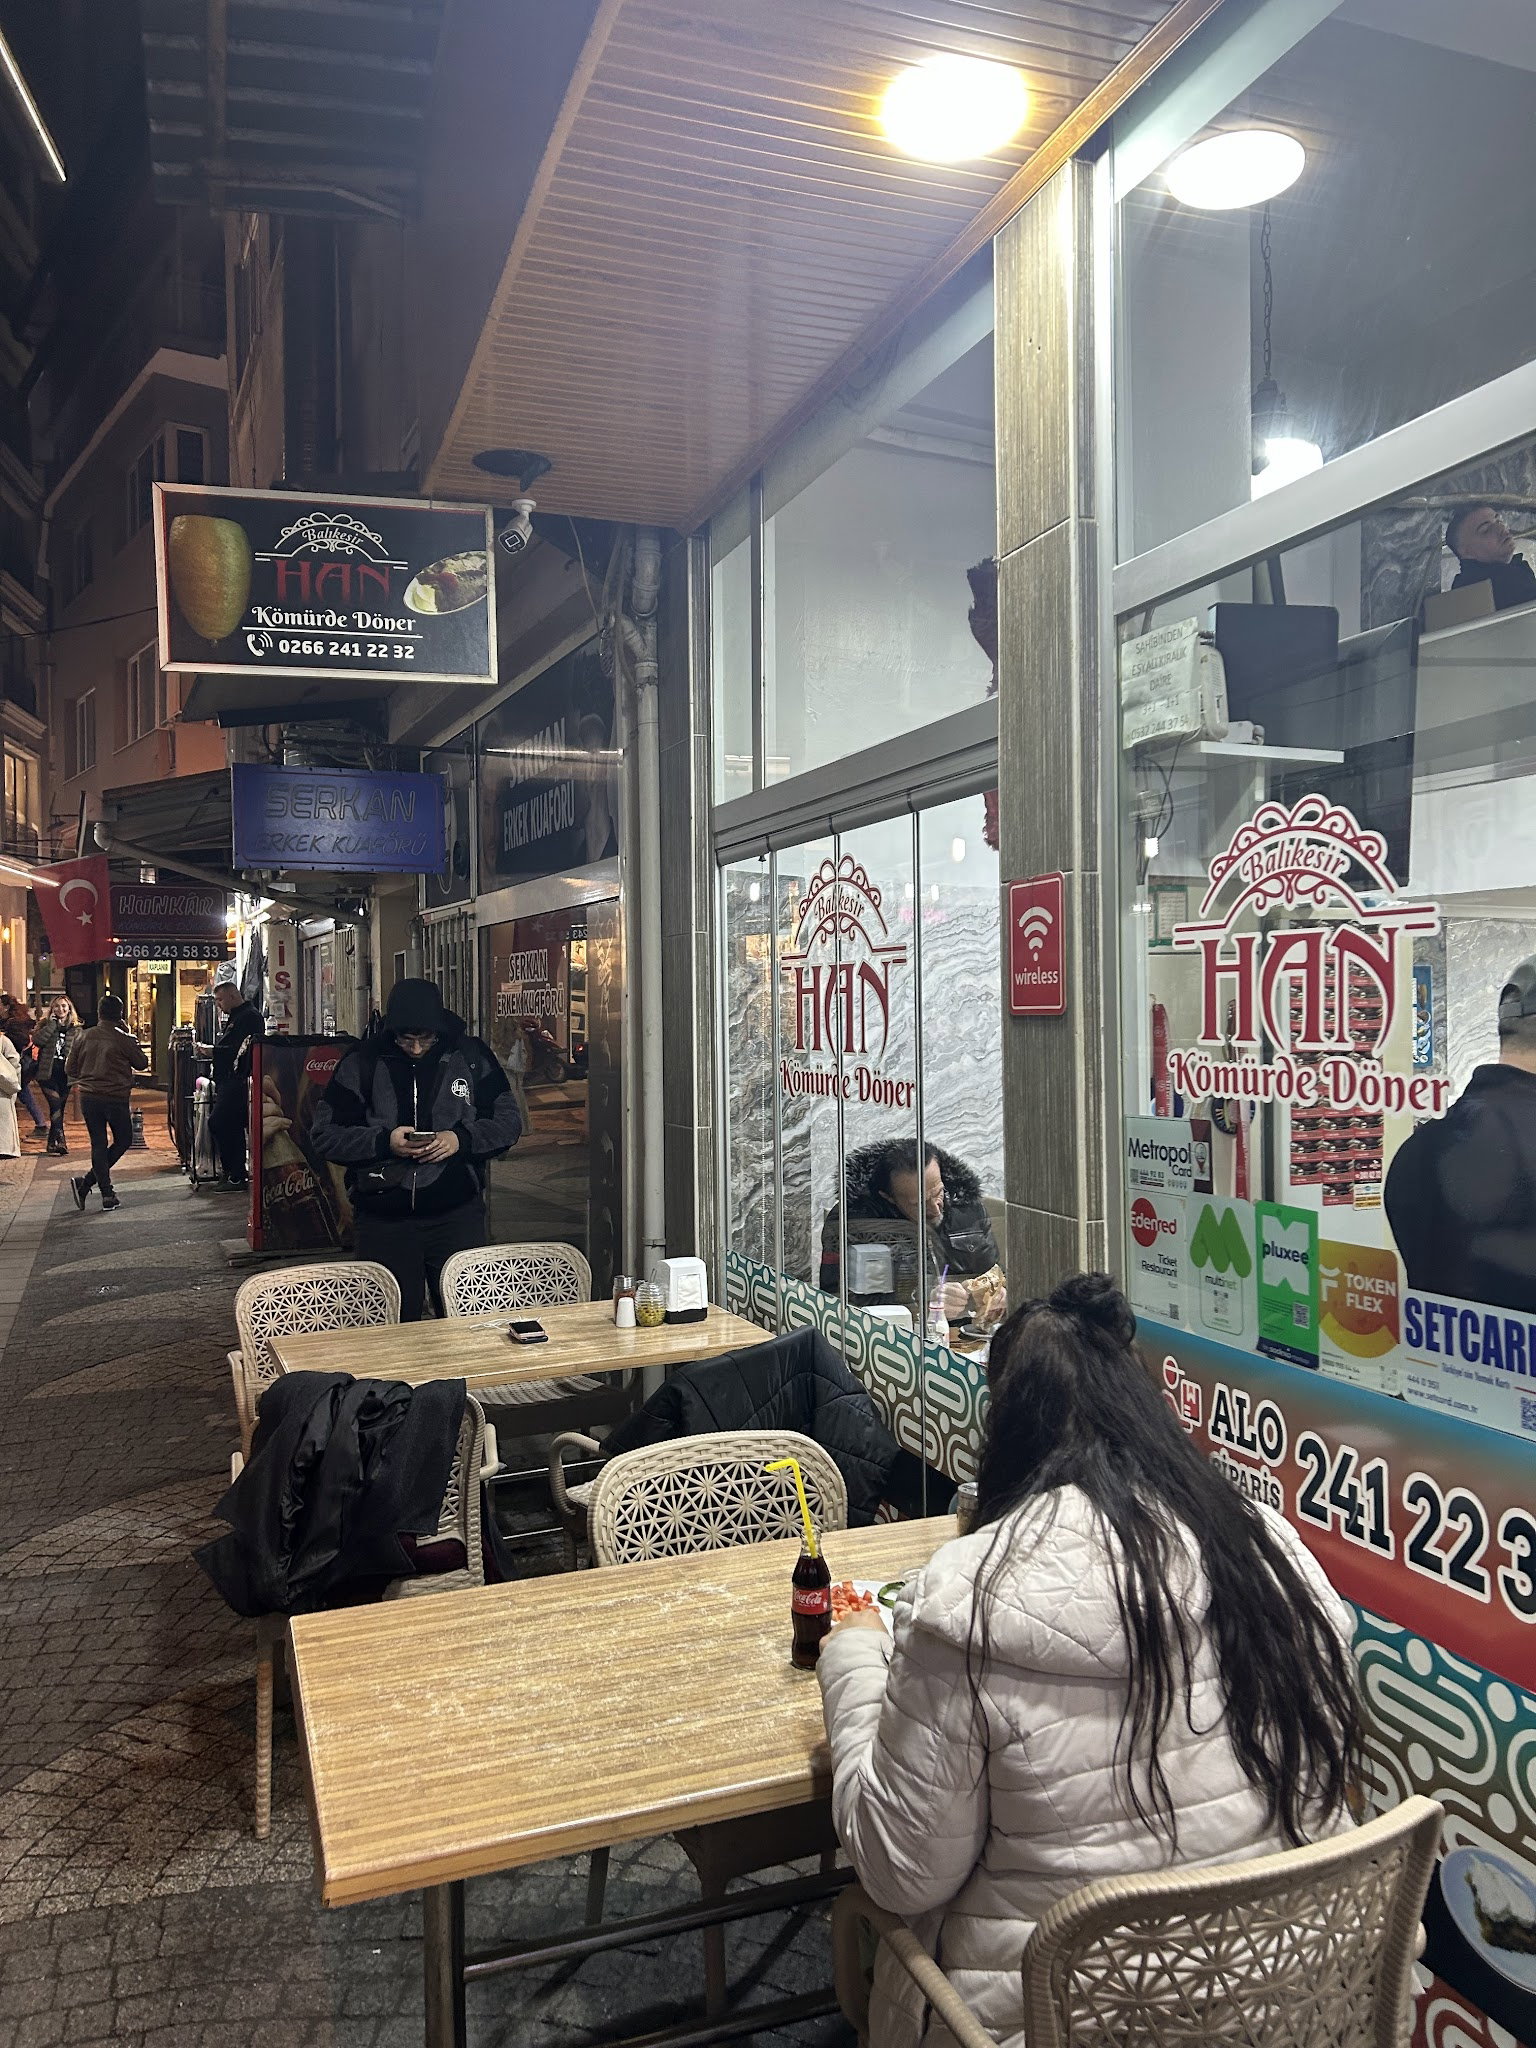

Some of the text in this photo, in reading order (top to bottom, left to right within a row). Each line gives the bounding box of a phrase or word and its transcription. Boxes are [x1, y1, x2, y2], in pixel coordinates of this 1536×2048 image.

[301, 526, 364, 546] Balıkesir
[275, 559, 391, 604] HAN
[251, 606, 417, 632] Kömürde Döner
[278, 639, 415, 660] 0266 241 22 32
[510, 717, 566, 789] SERKAN
[264, 782, 416, 823] SERKAN
[503, 801, 529, 852] ERKEK
[255, 832, 325, 854] ERKEK
[1241, 838, 1348, 886] Balıkesir
[116, 945, 219, 958] 0266 243 58 33
[509, 948, 548, 984] SERKAN
[1014, 966, 1059, 986] wireless
[496, 982, 565, 1018] ERKEK KUAFÖRÜ
[1199, 926, 1400, 1052] HAN
[794, 960, 889, 1060] HAN
[305, 1058, 341, 1072] Coca-Col
[779, 1059, 915, 1109] Kömürde Döner
[1170, 1052, 1315, 1101] Kömürde
[1323, 1060, 1451, 1116] Döner
[1128, 1136, 1192, 1167] Metropol
[1171, 1163, 1193, 1178] Card
[1130, 1210, 1177, 1235] Edenred
[1157, 1253, 1178, 1268] Ticket
[1262, 1240, 1309, 1265] pluxee
[1141, 1259, 1178, 1278] Restaurant
[1204, 1274, 1238, 1291] multinet
[1343, 1272, 1397, 1297] TOKEN
[1345, 1292, 1384, 1315] FLEX
[1210, 1387, 1285, 1463] ALO
[1298, 1437, 1391, 1554] 241
[1405, 1478, 1488, 1597] 22
